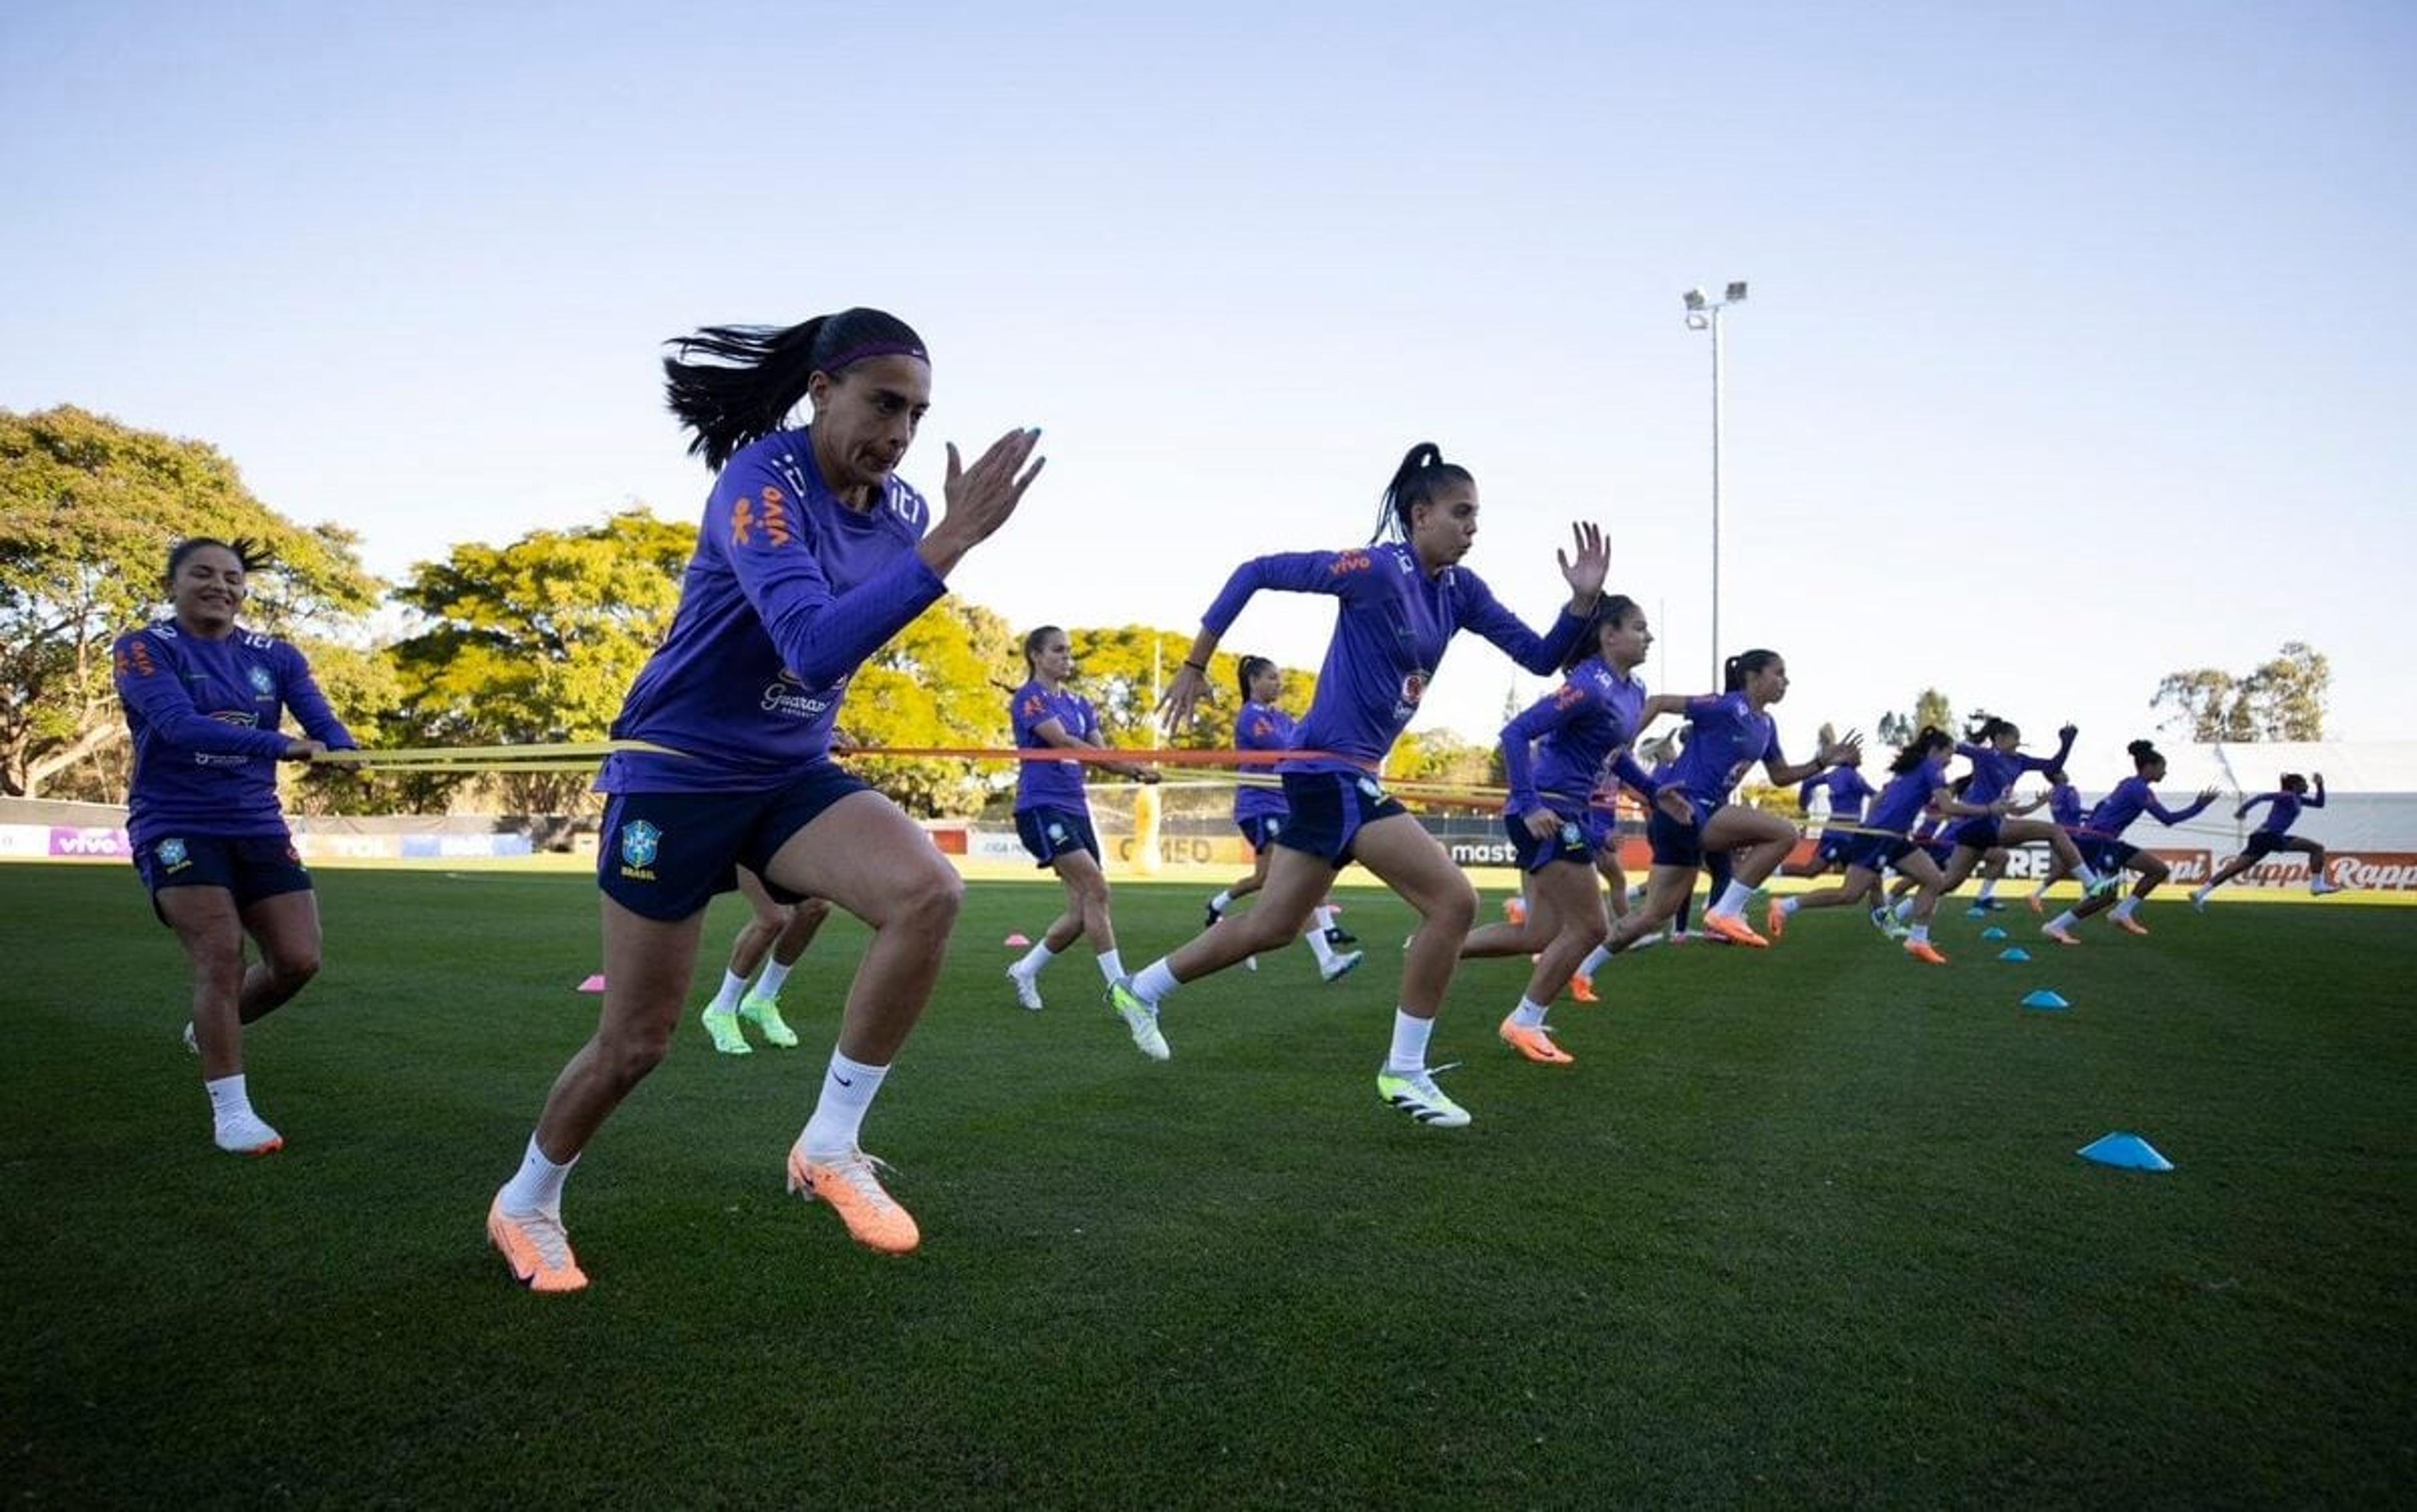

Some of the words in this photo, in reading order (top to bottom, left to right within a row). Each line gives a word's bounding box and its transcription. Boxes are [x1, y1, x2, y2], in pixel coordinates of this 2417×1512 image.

[762, 486, 789, 546] vivo
[1330, 558, 1370, 575] vivo
[59, 837, 116, 854] vivo
[1120, 838, 1212, 863] CMED
[1452, 842, 1519, 862] mast
[2006, 849, 2050, 878] RE
